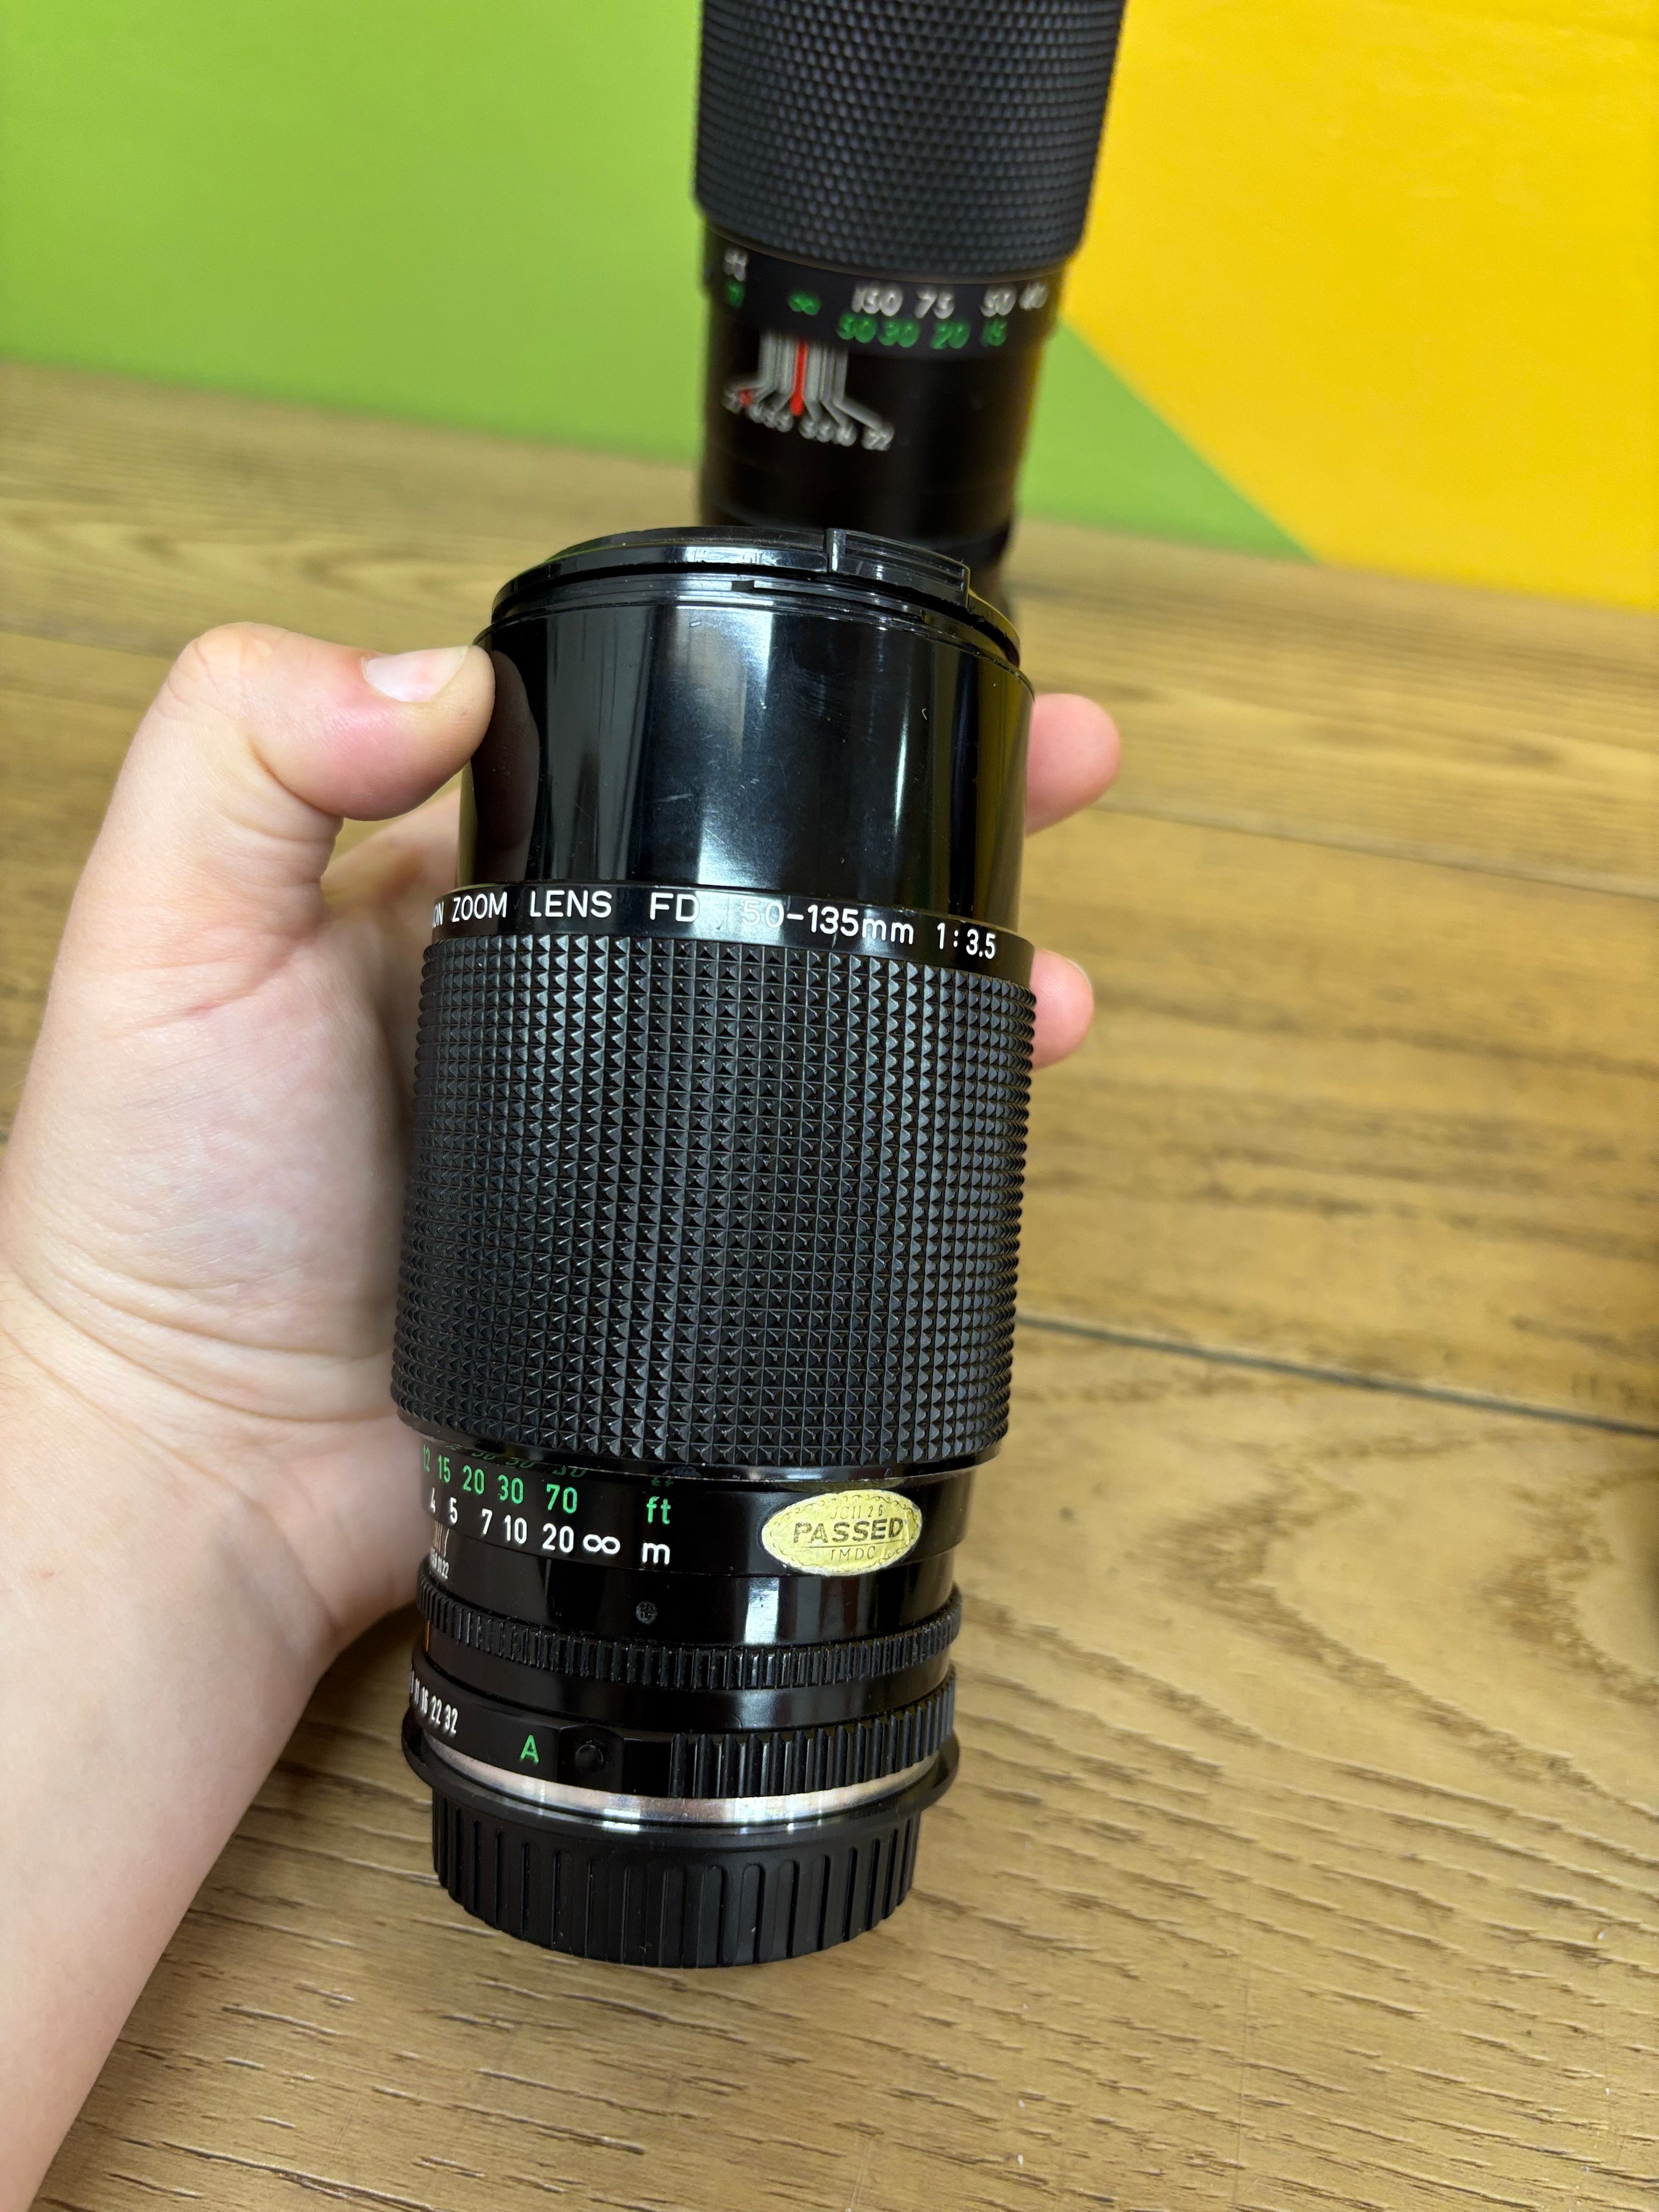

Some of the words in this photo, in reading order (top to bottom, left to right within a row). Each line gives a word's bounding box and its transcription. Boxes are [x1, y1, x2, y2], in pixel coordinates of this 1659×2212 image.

[452, 892, 507, 922] ZOOM
[530, 890, 612, 918] LENS
[650, 893, 700, 922] FD
[424, 1444, 430, 1472] 12
[438, 1454, 451, 1483] 15
[462, 1465, 485, 1495] 20
[498, 1474, 524, 1504] 30
[546, 1483, 578, 1514] 70
[647, 1496, 672, 1525] ft
[449, 1497, 458, 1524] 5
[482, 1509, 493, 1535] 7
[504, 1514, 528, 1544] 10
[542, 1523, 574, 1553] 20
[642, 1541, 670, 1565] m
[793, 1517, 904, 1544] PASSED
[421, 1686, 429, 1714] 16
[431, 1695, 442, 1725] 22
[444, 1704, 458, 1734] 32
[520, 1734, 540, 1765] A
